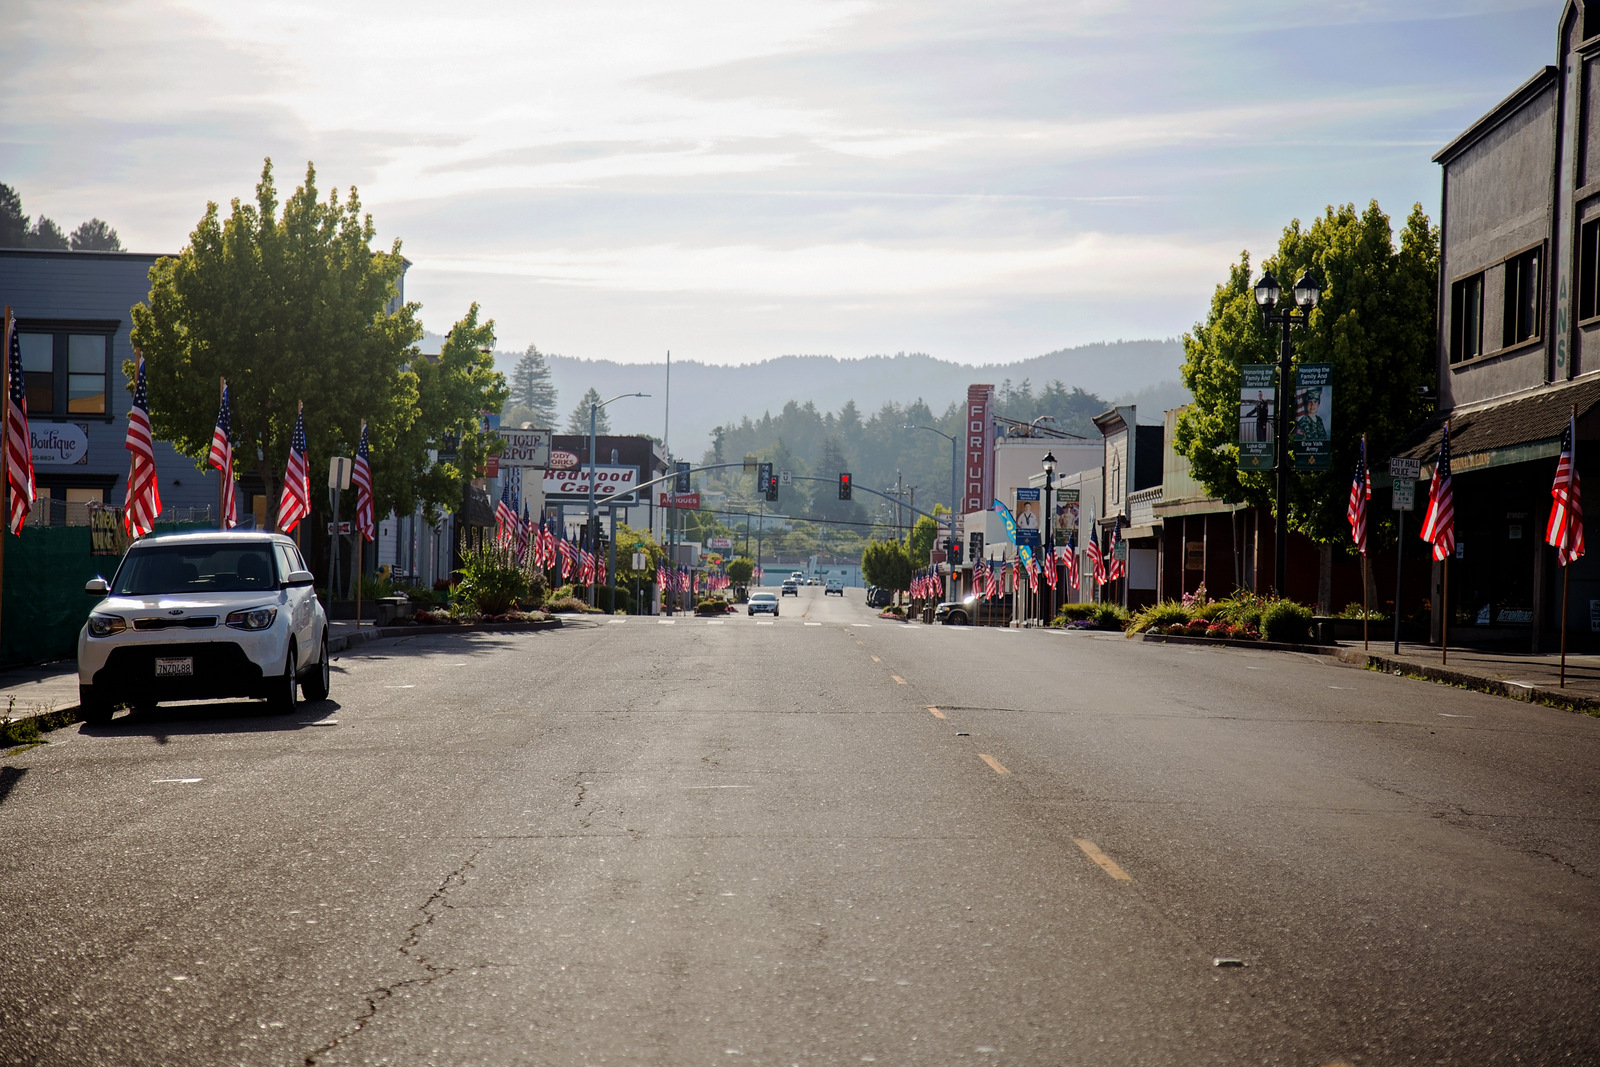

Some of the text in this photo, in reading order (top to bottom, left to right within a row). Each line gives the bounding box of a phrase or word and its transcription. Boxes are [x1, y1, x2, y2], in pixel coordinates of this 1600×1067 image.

[30, 430, 76, 460] Boutique
[969, 405, 982, 509] FORTUNA
[543, 470, 633, 482] Redwood
[1392, 467, 1409, 476] POLICE
[560, 482, 616, 493] Cafe
